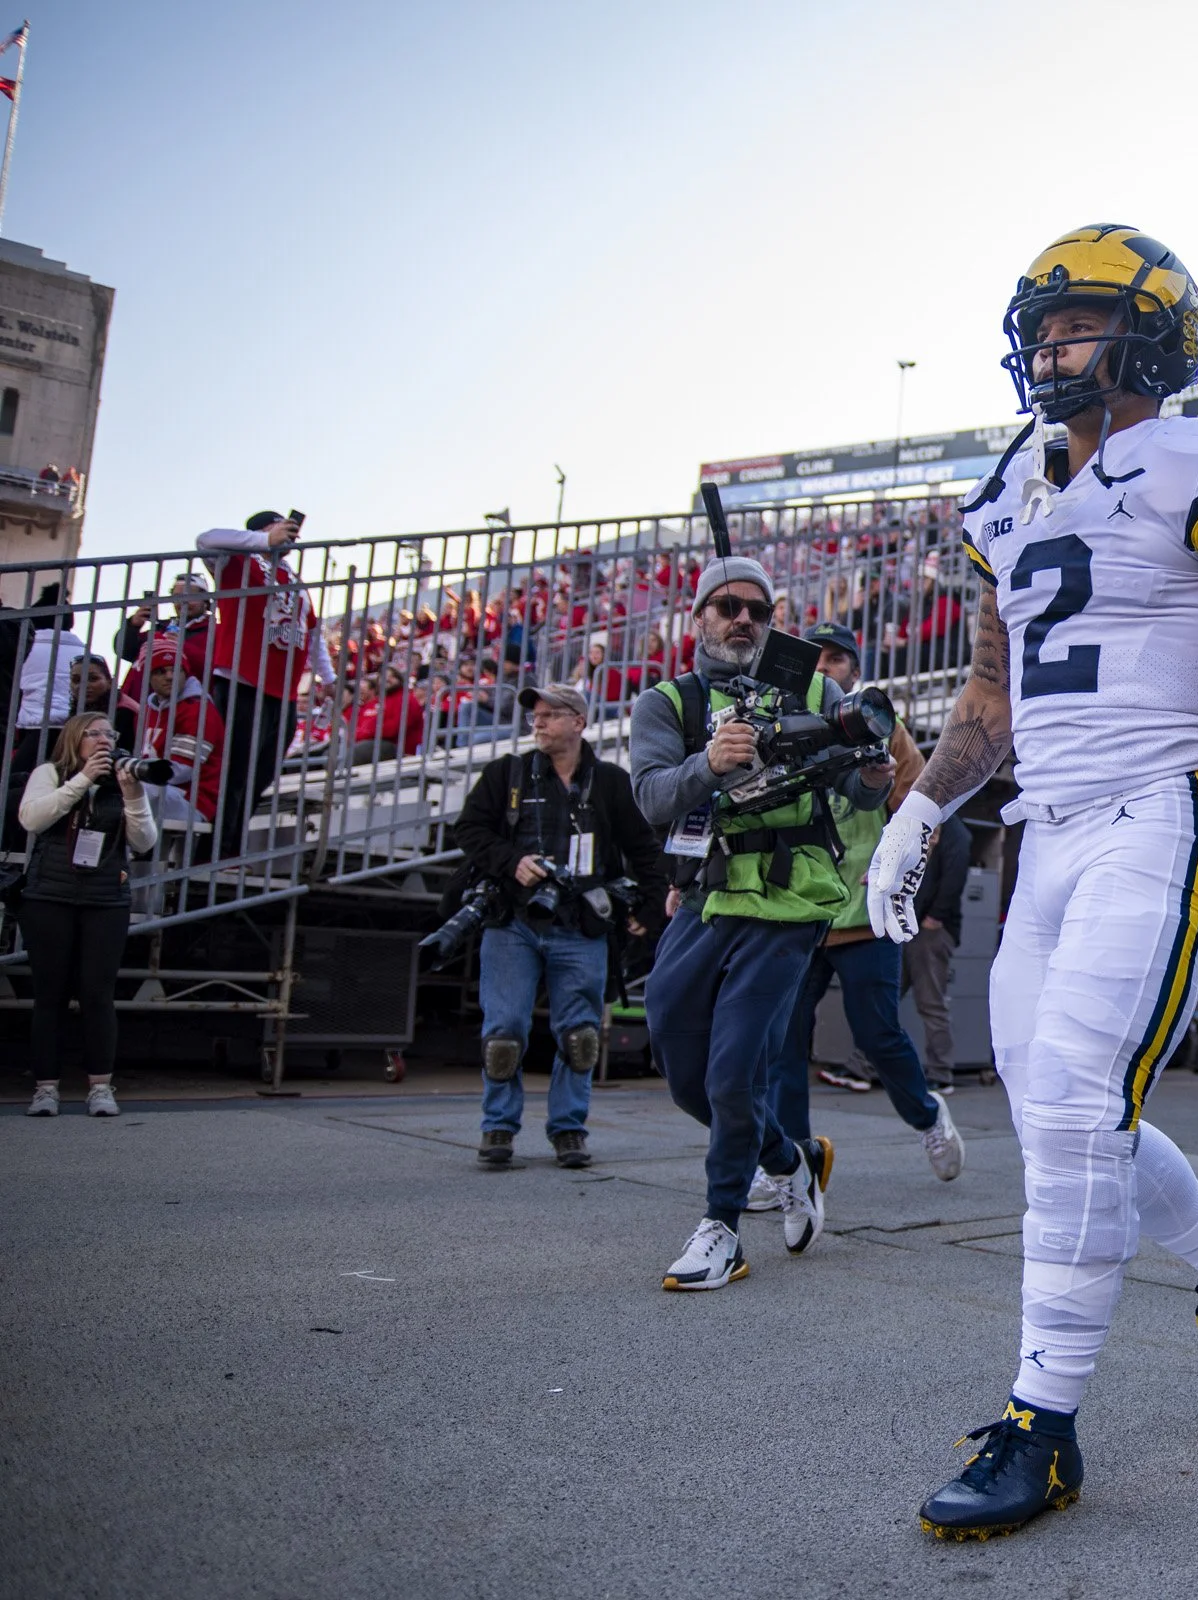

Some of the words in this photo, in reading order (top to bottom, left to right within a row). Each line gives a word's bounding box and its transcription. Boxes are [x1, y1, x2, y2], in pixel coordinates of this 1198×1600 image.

[1035, 273, 1049, 287] M
[17, 319, 80, 347] Wolstein
[1010, 532, 1101, 700] 2
[1001, 1401, 1036, 1432] M
